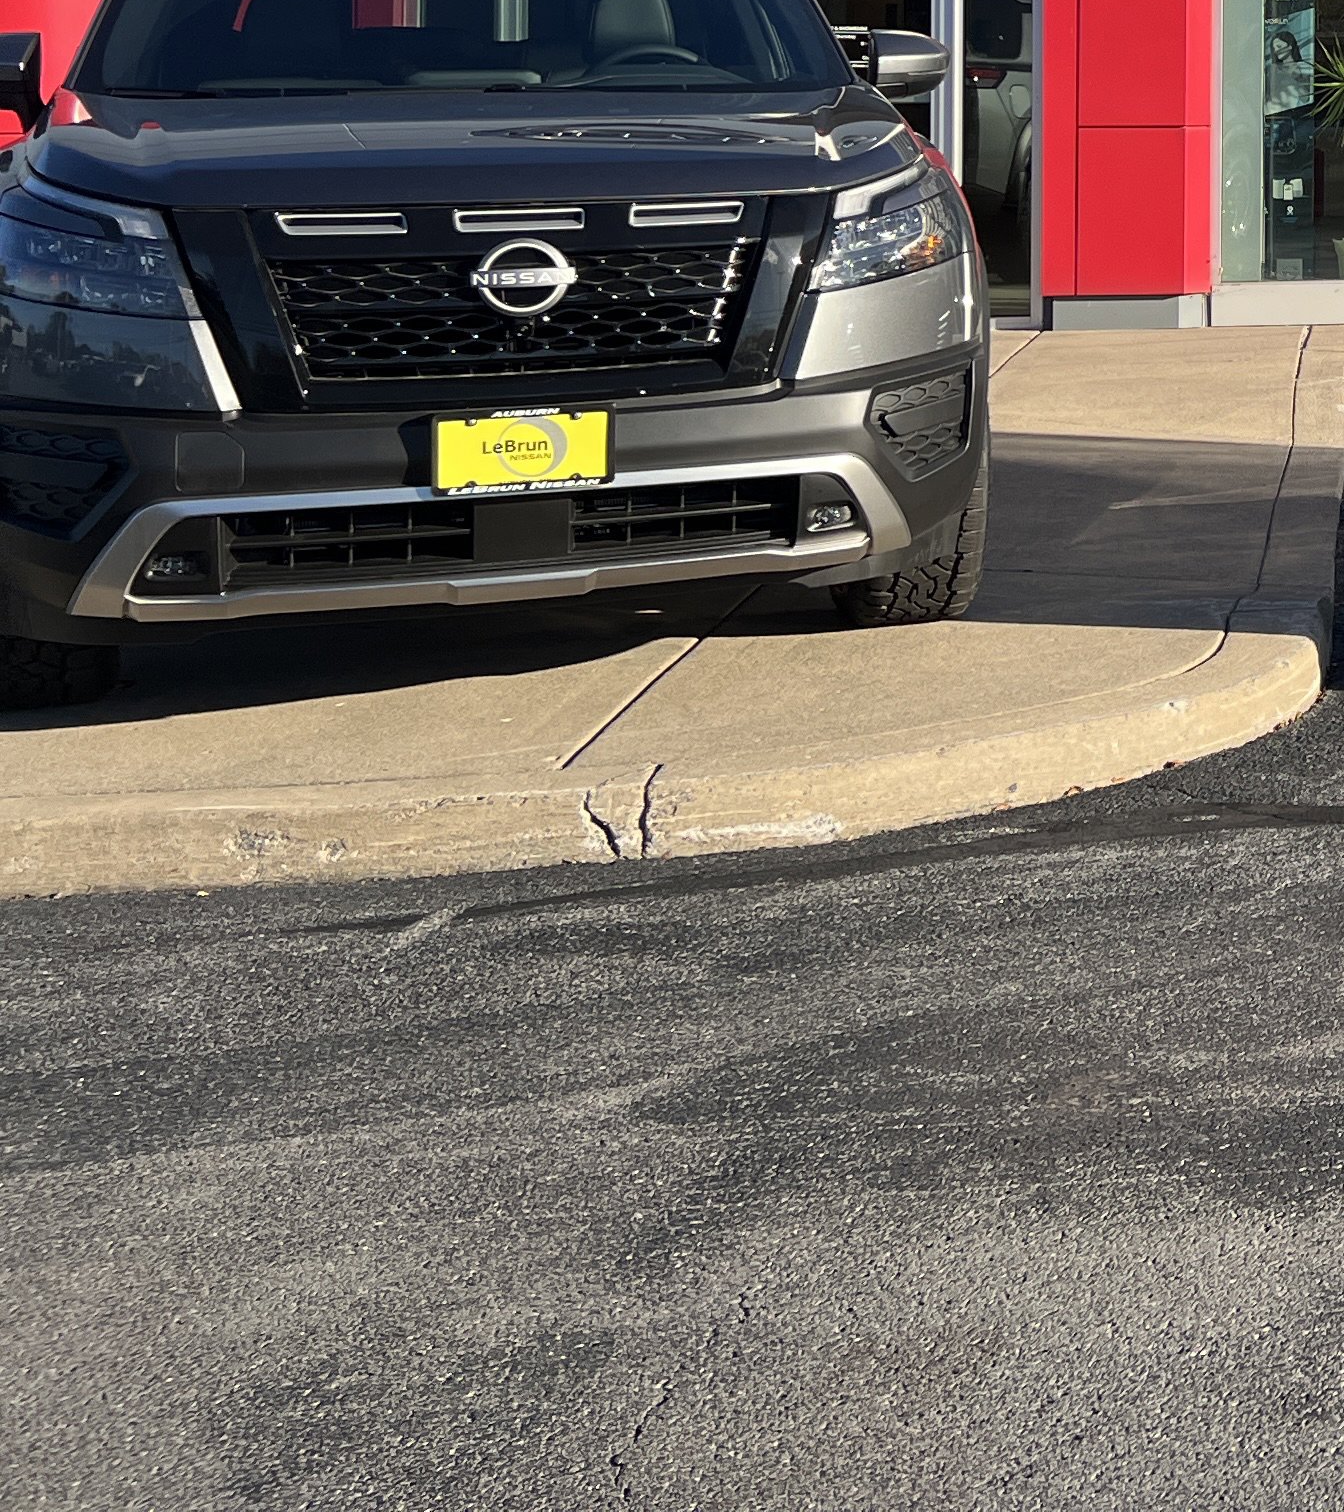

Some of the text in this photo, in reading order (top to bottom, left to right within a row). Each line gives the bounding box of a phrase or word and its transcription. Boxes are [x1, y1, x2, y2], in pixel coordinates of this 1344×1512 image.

[472, 271, 576, 286] NISSAN
[490, 407, 560, 419] AUBURN
[482, 439, 548, 455] LeBrun
[509, 453, 552, 462] NISSAN
